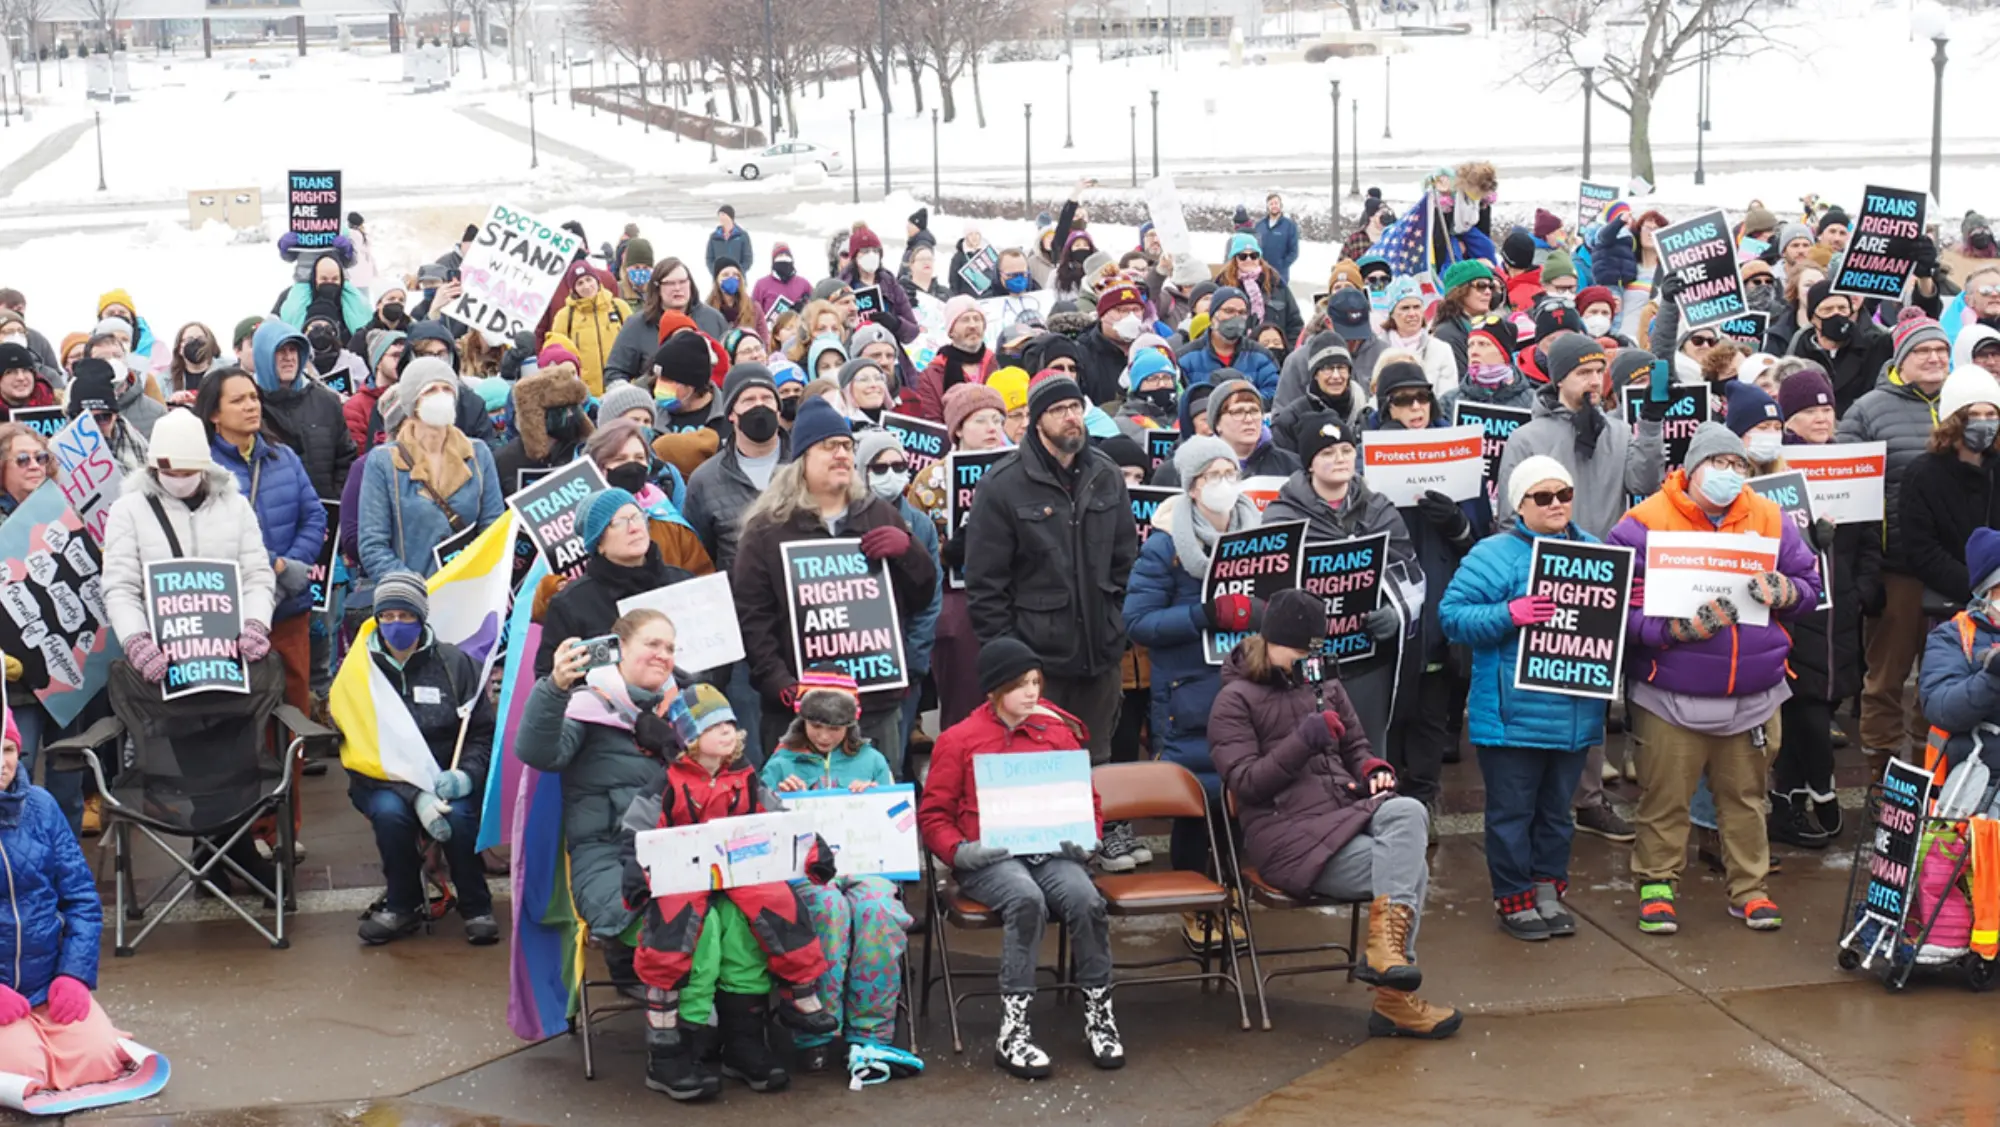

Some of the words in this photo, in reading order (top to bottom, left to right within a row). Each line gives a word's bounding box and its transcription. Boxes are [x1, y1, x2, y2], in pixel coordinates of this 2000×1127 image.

[291, 176, 333, 189] TRANS
[291, 191, 337, 203] RIGHTS
[1866, 195, 1917, 217] TRANS
[292, 205, 318, 217] ARE
[292, 219, 338, 231] HUMAN
[493, 205, 575, 253] DOCTORS
[1662, 223, 1717, 250] TRANS
[1861, 216, 1918, 239] RIGHTS
[478, 222, 568, 276] STAND
[1669, 240, 1728, 269] RIGHTS
[1855, 236, 1890, 253] ARE
[489, 260, 534, 286] WITH
[1847, 253, 1909, 274] HUMAN
[1840, 271, 1900, 291] RIGHTS.
[456, 292, 524, 338] KIDS
[1686, 294, 1743, 323] RIGHTS.
[1374, 449, 1417, 461] Protect
[1418, 448, 1448, 460] trans
[1449, 445, 1474, 457] kids.
[1405, 474, 1446, 485] ALWAYS
[1828, 464, 1853, 475] trans
[522, 477, 592, 522] TRANS
[1814, 491, 1850, 502] ALWAYS
[47, 532, 64, 553] The
[1219, 532, 1288, 558] TRANS
[793, 553, 869, 583] TRANS
[1214, 553, 1290, 579] RIGHTS
[1307, 548, 1373, 574] TRANS
[1541, 554, 1615, 582] TRANS
[1659, 553, 1706, 567] Protect
[1708, 557, 1738, 569] trans
[1741, 559, 1765, 571] kids.
[154, 571, 225, 592] TRANS
[798, 578, 881, 606] RIGHTS
[1305, 569, 1374, 595] RIGHTS
[1539, 580, 1617, 609] RIGHTS
[1692, 583, 1733, 595] ALWAYS
[157, 594, 233, 616] RIGHTS
[161, 616, 204, 640] ARE
[804, 606, 850, 632] ARE
[163, 638, 238, 662] HUMAN
[806, 628, 891, 657] HUMAN
[1530, 630, 1613, 661] HUMAN
[169, 660, 244, 686] RIGHTS.
[1528, 658, 1612, 687] RIGHTS.
